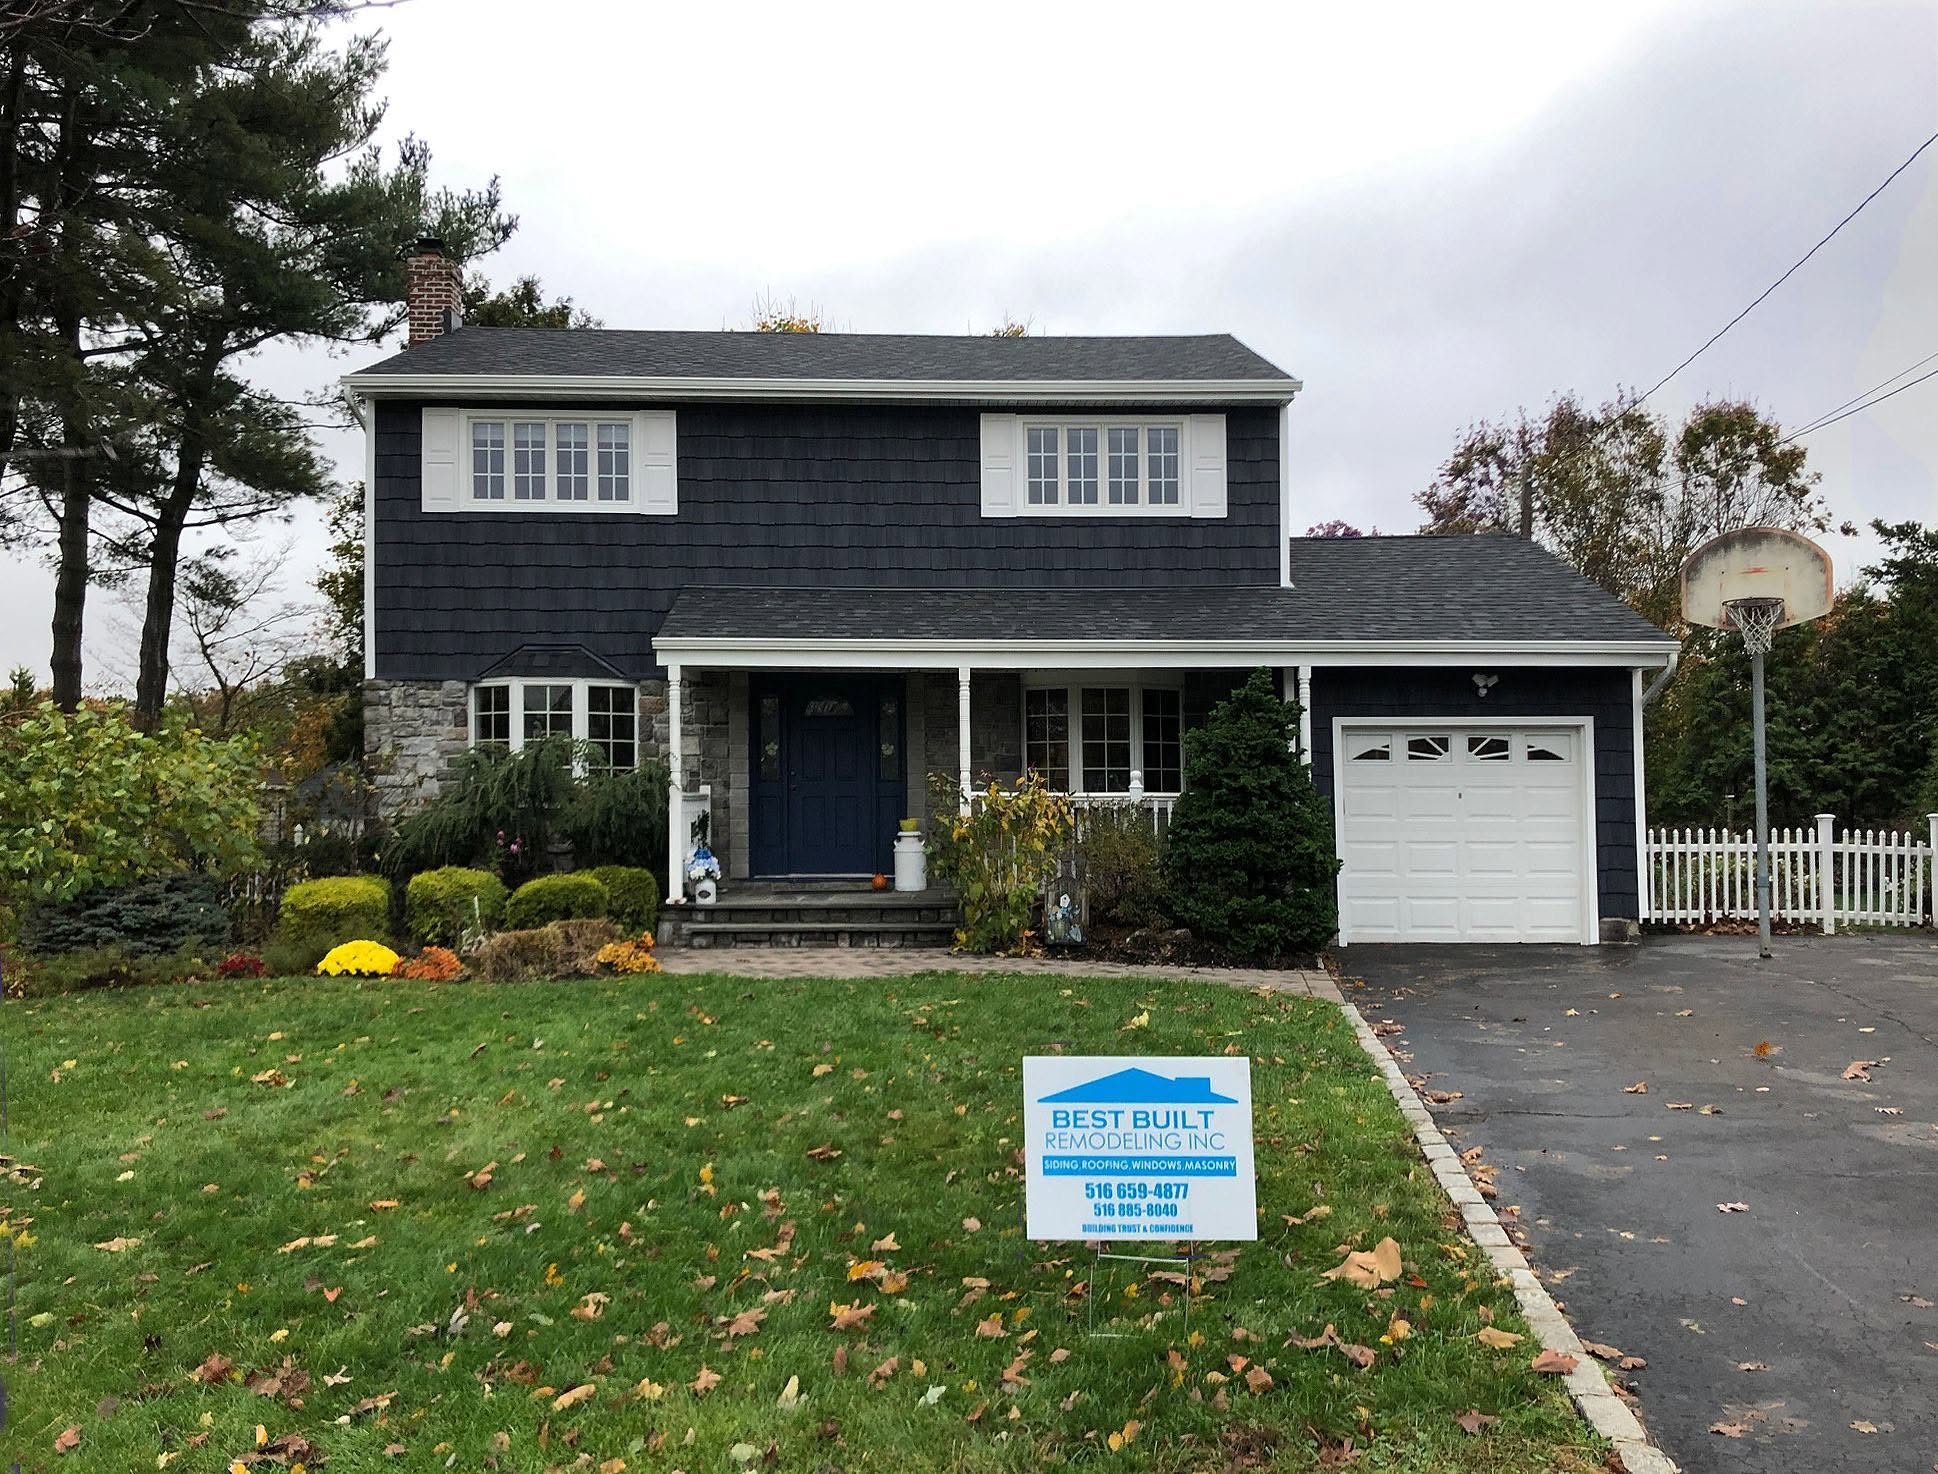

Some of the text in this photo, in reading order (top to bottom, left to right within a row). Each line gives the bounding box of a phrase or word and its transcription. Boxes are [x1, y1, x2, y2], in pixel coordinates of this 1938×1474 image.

[1052, 1110, 1215, 1129] BEST BUILT
[1045, 1132, 1225, 1150] REMODELING INC
[1085, 1182, 1189, 1199] 516 659-4877
[1093, 1203, 1178, 1217] 516 885-8040
[1082, 1224, 1194, 1233] BUILDING TRUST & CONFIDENCE
